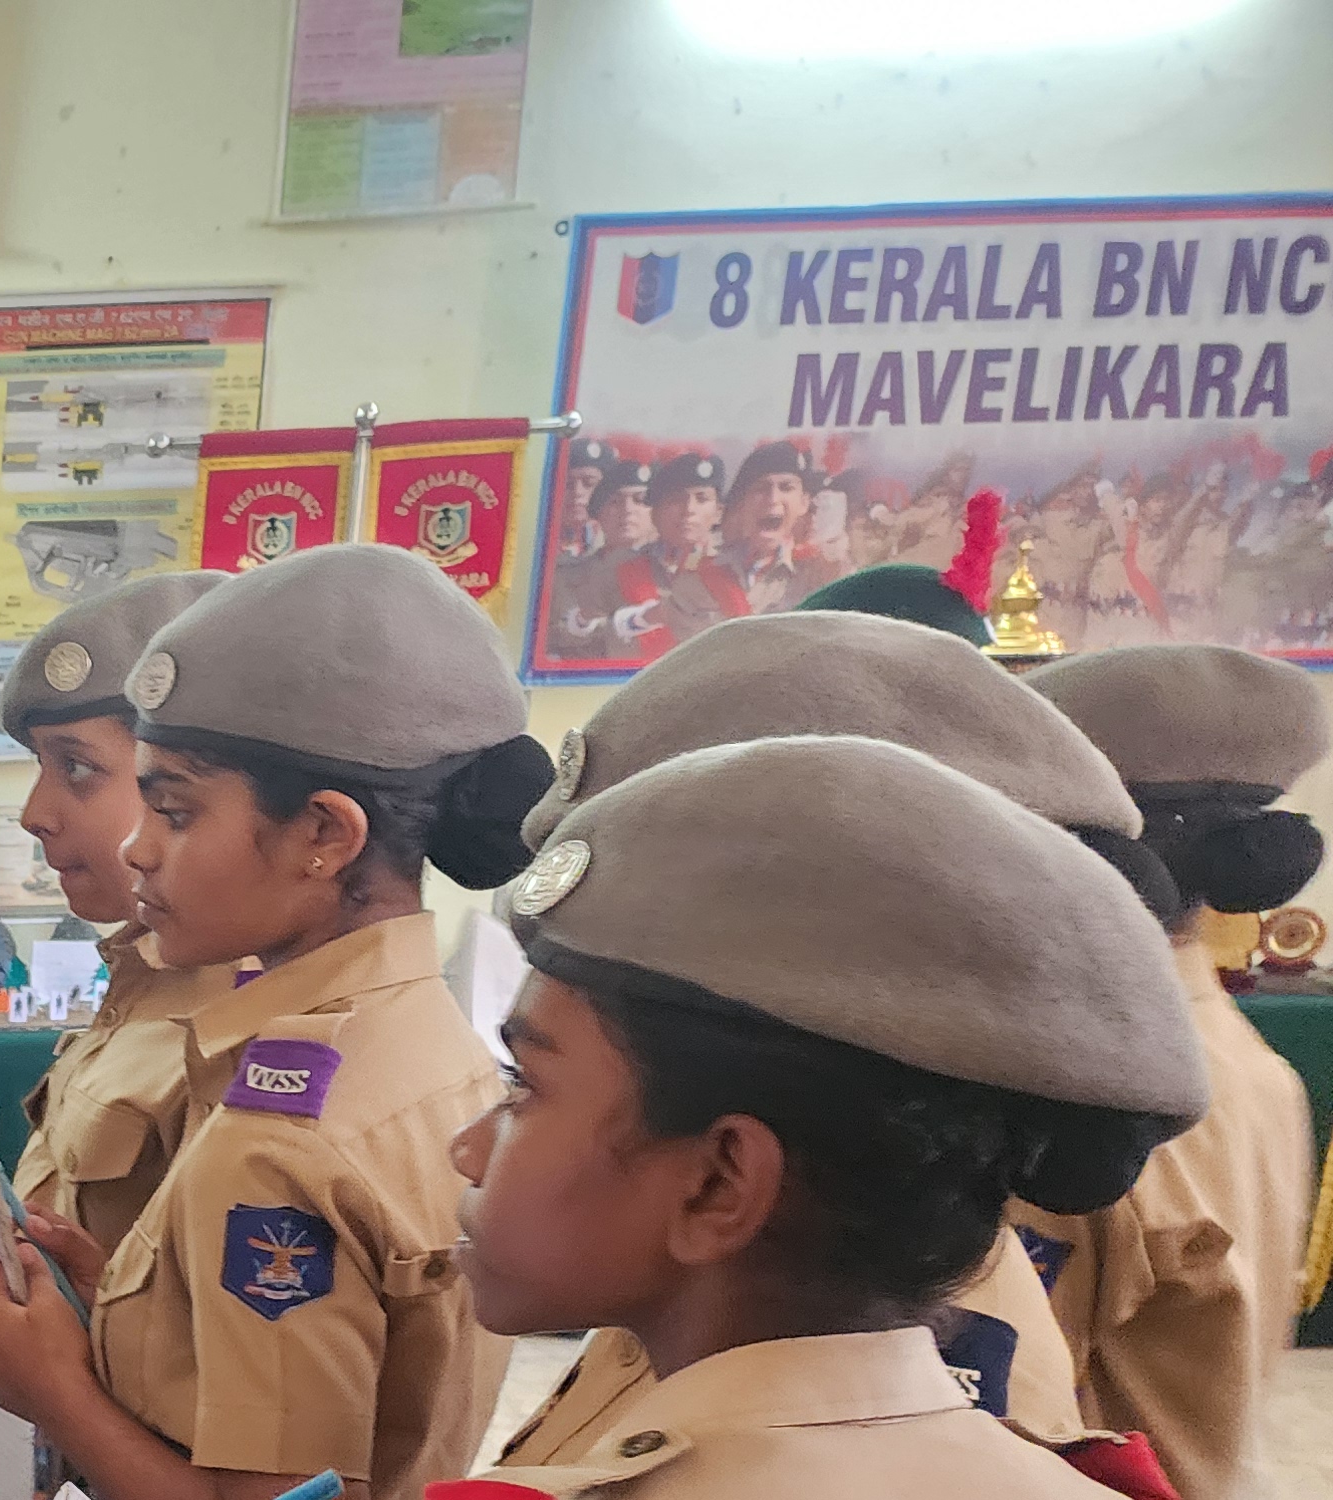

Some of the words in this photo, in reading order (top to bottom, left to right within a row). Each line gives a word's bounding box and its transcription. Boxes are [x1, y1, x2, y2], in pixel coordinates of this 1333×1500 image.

[709, 251, 752, 328] 8
[780, 241, 1063, 326] KERALA
[1093, 239, 1200, 319] BN
[788, 341, 1290, 428] MAVELIKARA
[228, 480, 283, 516] KERALA
[400, 469, 456, 507] KERALA
